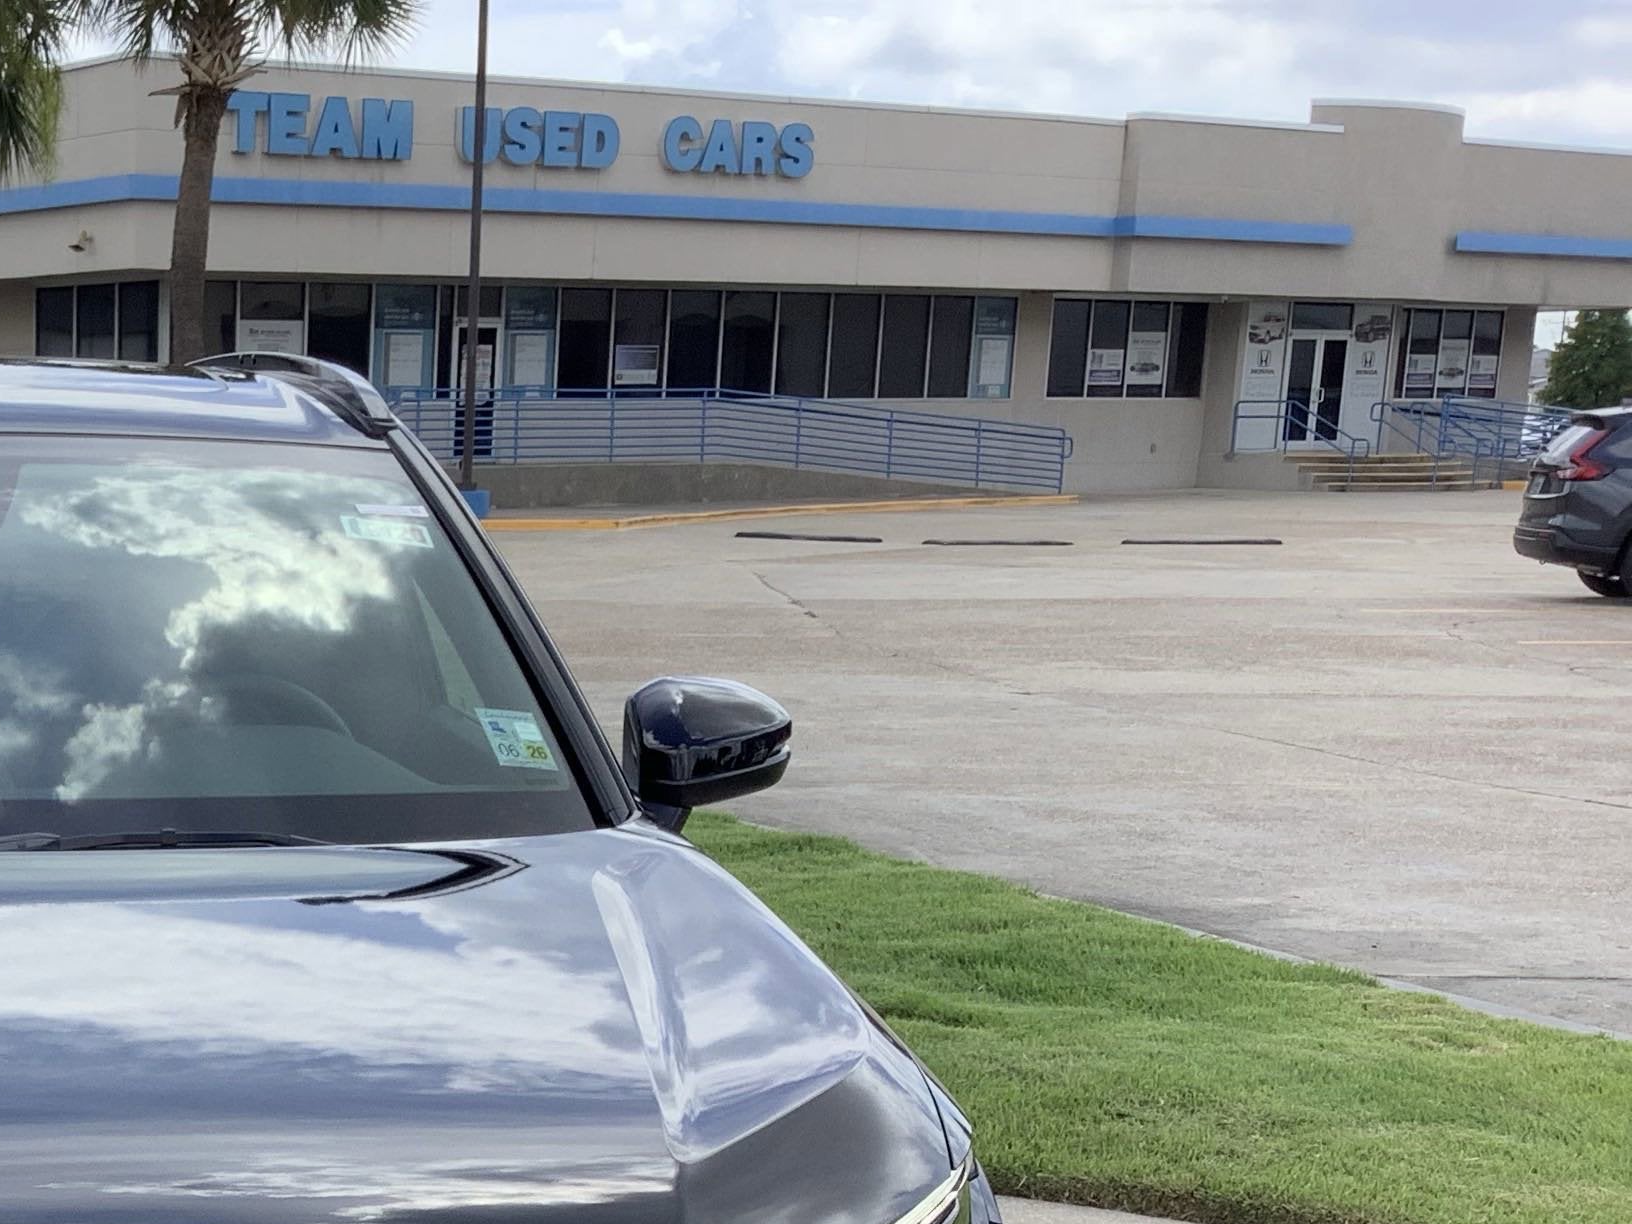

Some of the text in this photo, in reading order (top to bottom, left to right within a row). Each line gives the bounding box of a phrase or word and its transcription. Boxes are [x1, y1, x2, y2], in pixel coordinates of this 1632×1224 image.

[227, 91, 815, 179] TEAM USED CARS
[498, 743, 548, 760] 06 26
